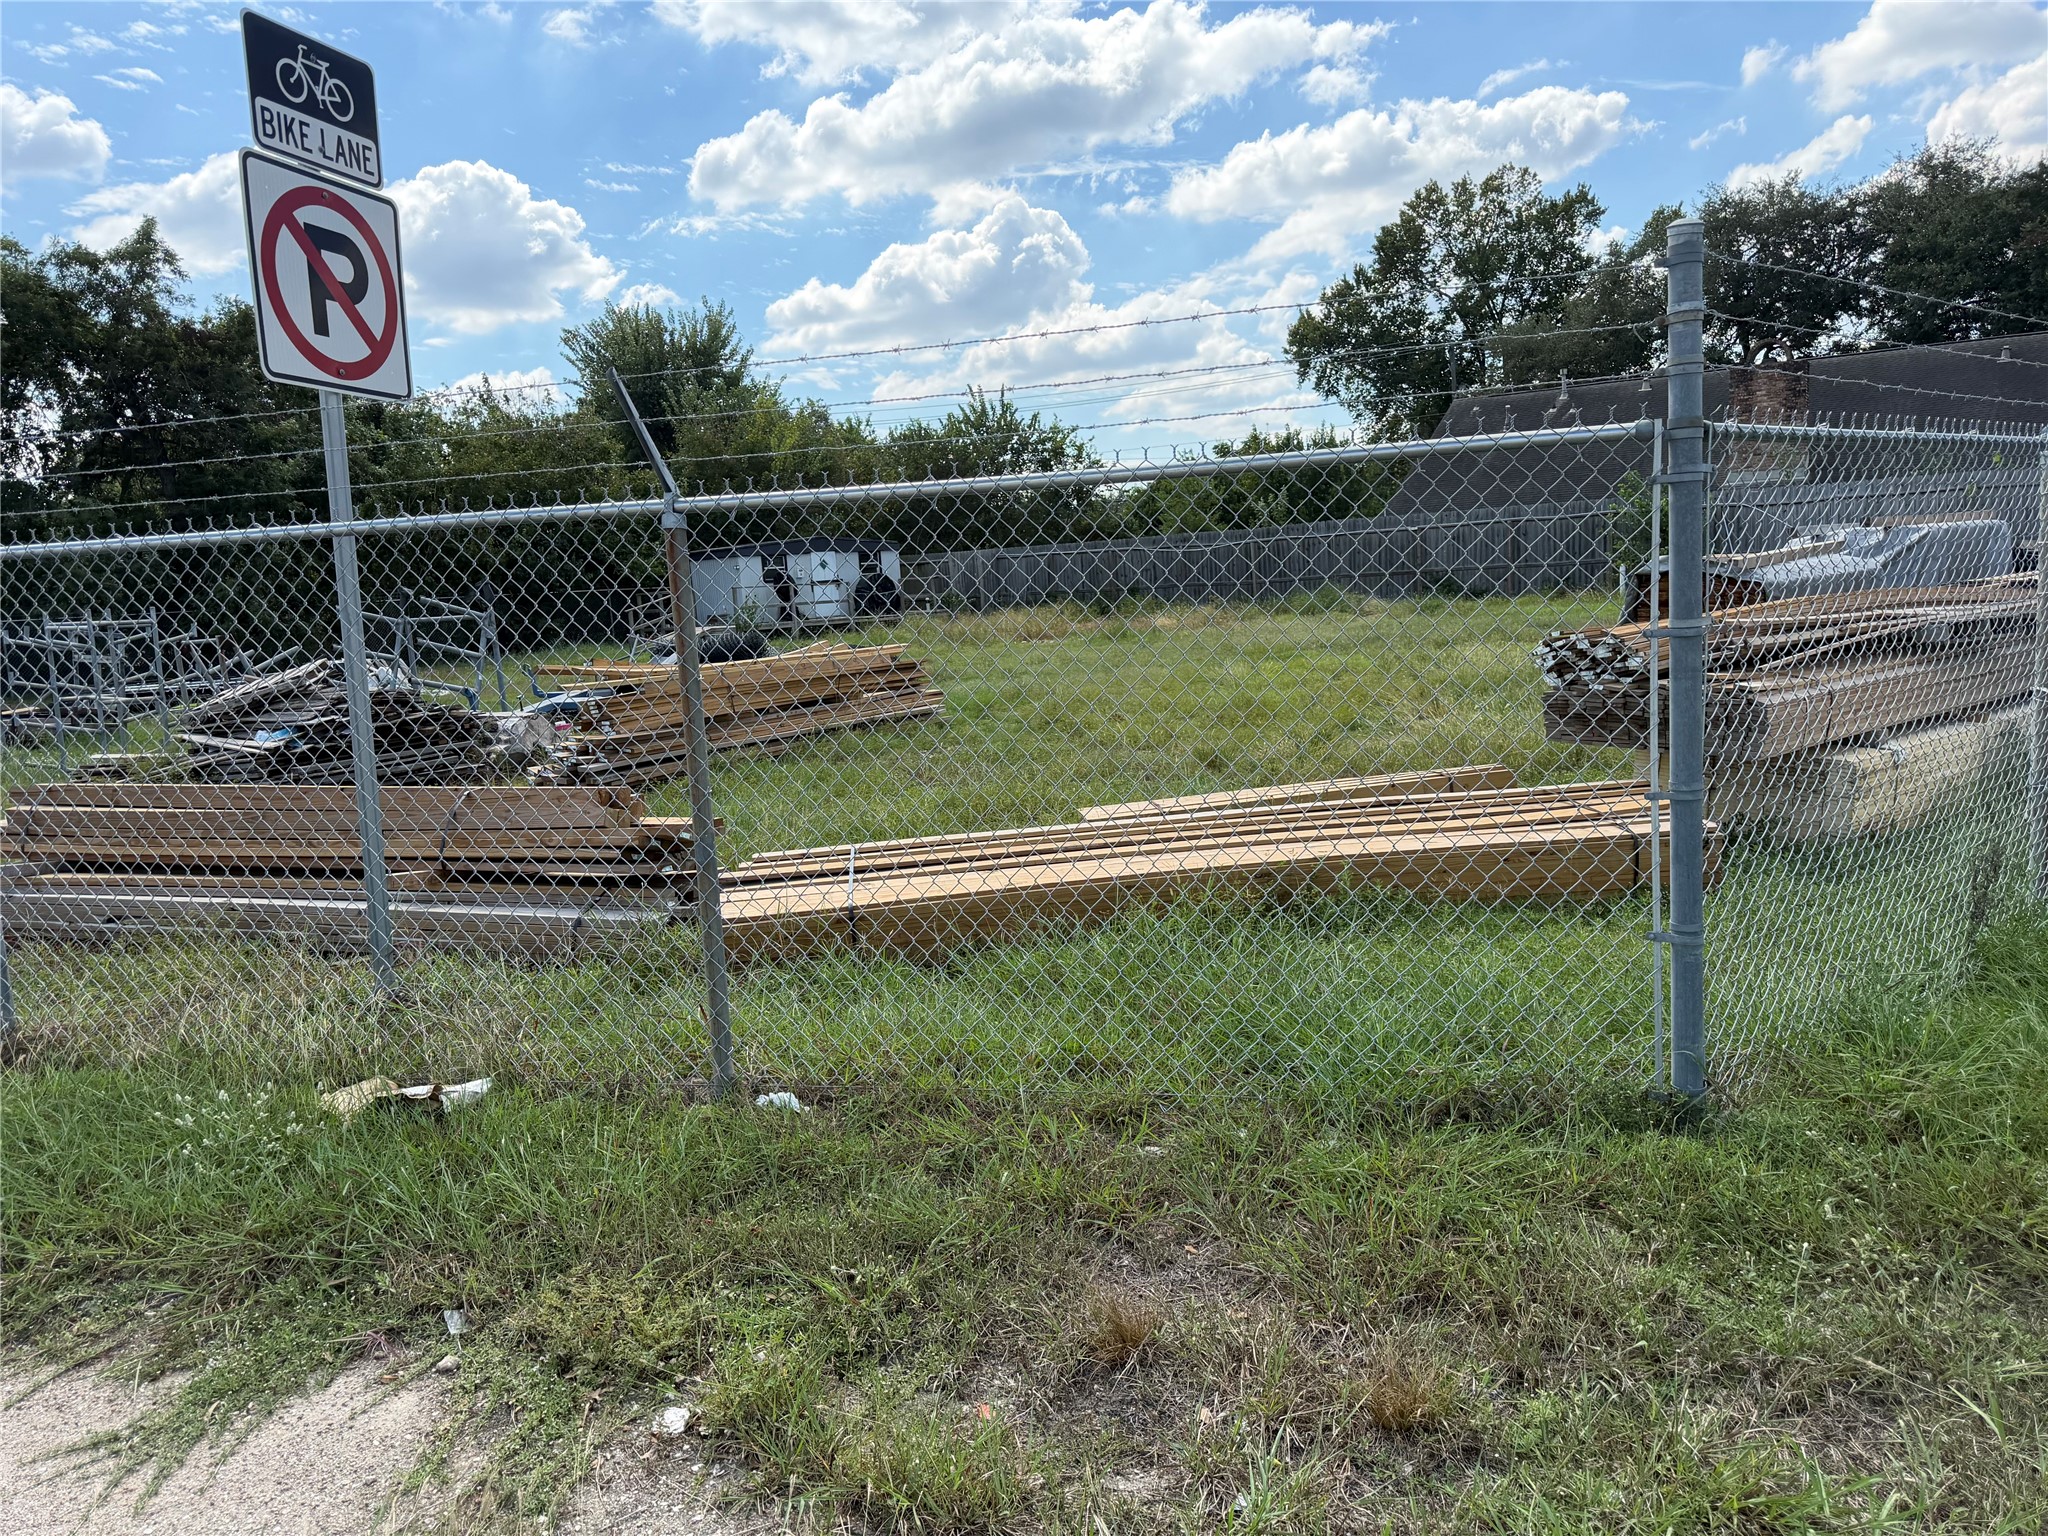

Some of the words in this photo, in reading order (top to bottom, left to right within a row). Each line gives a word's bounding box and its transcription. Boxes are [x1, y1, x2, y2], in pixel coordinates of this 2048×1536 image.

[260, 105, 313, 154] BIKE
[320, 128, 374, 176] LANE
[303, 222, 368, 338] P
